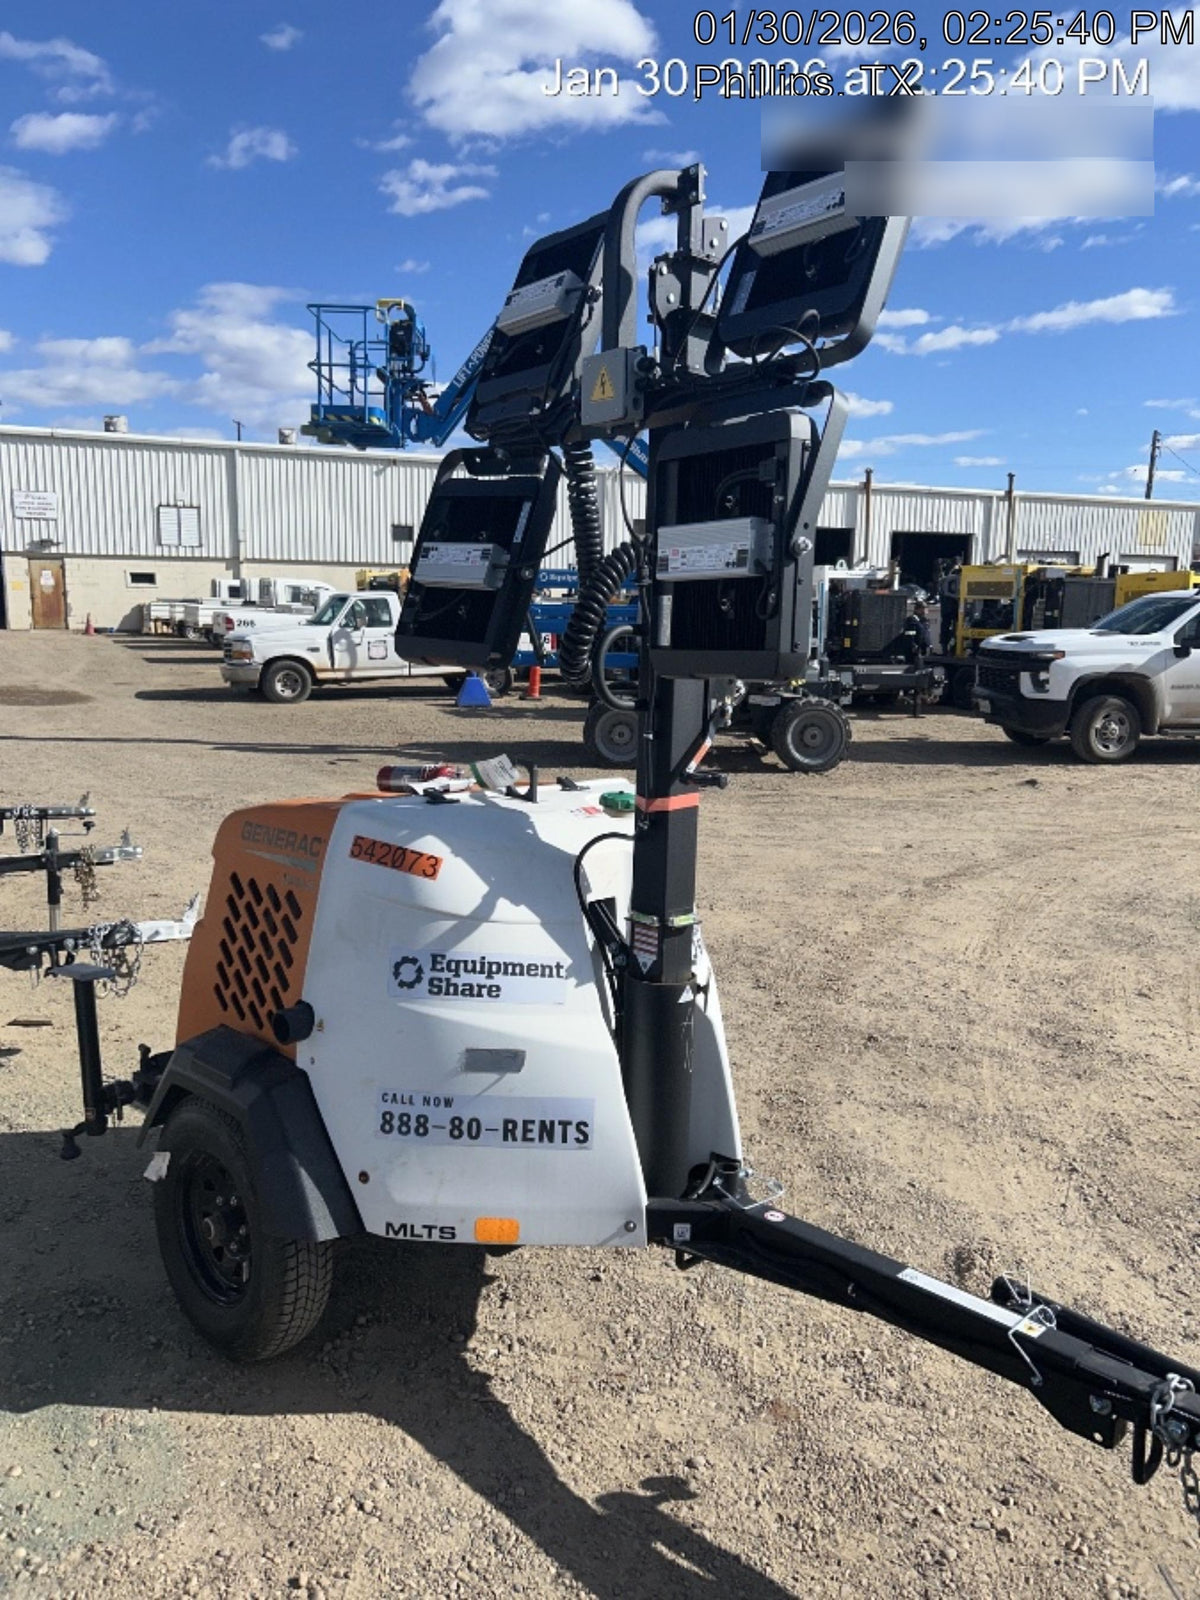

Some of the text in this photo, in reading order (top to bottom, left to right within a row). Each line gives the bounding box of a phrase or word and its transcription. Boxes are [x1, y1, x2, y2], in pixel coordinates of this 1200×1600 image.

[240, 820, 323, 858] GENERAC
[350, 834, 440, 878] 542073
[429, 953, 565, 980] Equipment
[427, 977, 502, 998] Share
[381, 1092, 454, 1108] CALL NOW
[379, 1110, 590, 1145] 888-80-RENTS
[385, 1221, 457, 1240] MLTS
